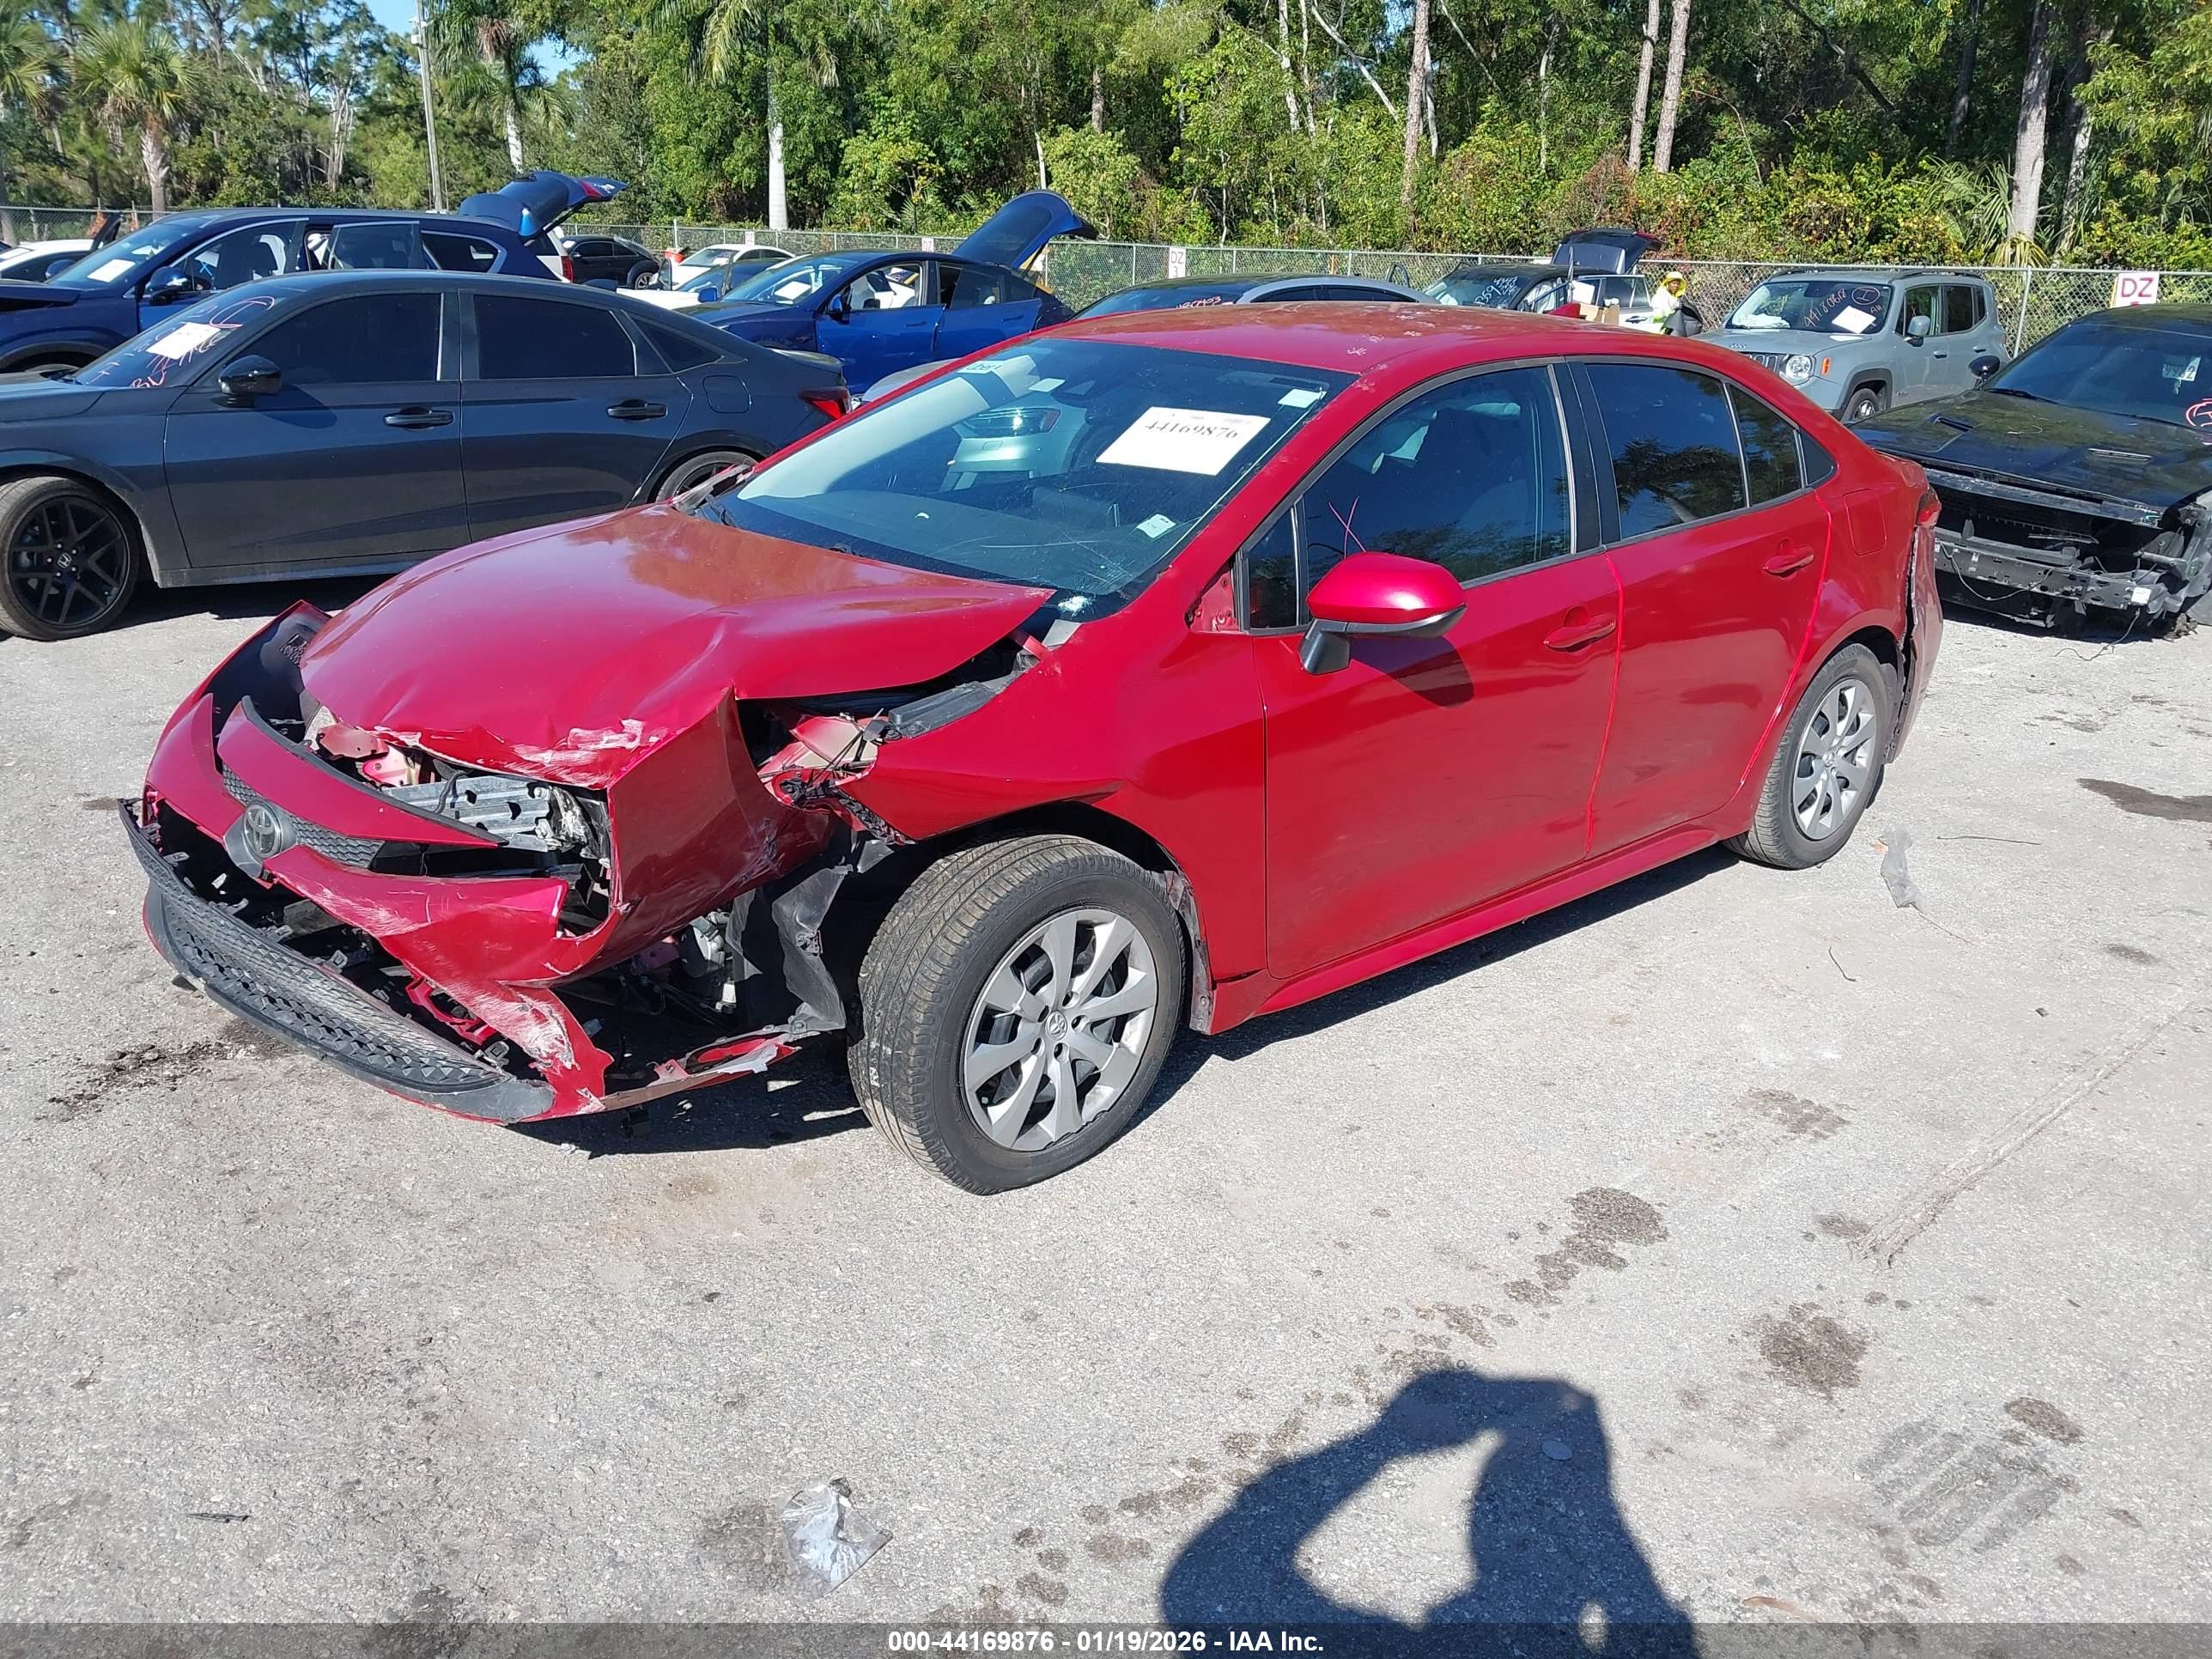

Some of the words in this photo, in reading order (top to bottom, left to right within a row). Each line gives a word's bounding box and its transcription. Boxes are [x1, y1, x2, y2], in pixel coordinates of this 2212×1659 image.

[1170, 251, 1184, 264] DZ
[2121, 277, 2154, 297] DZ
[1144, 421, 1238, 438] 44169876
